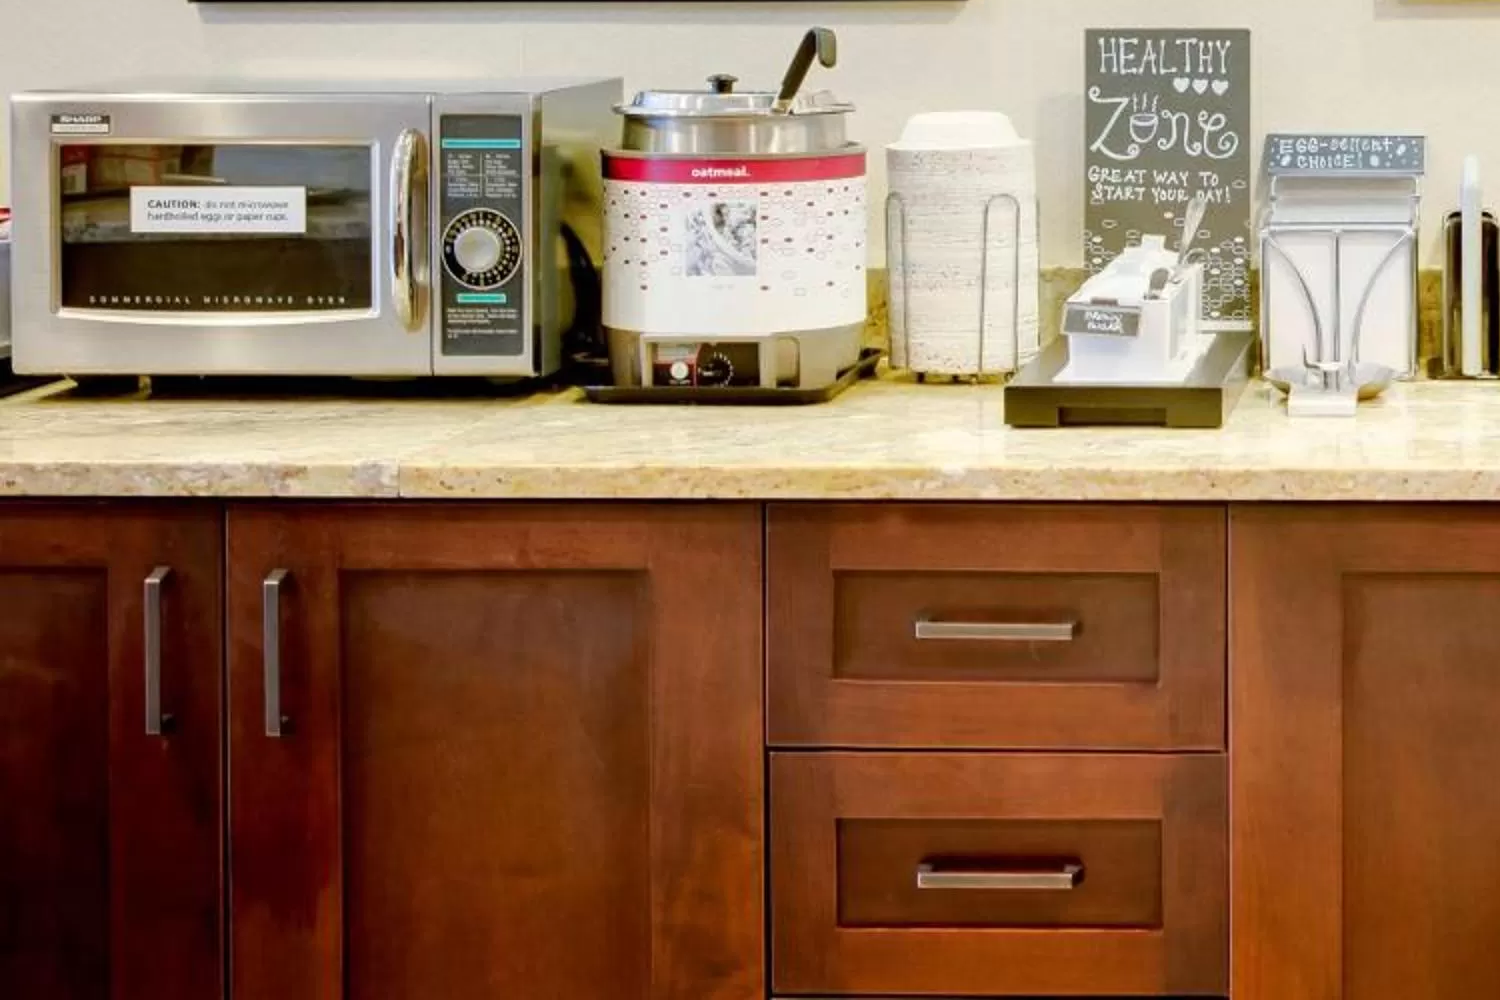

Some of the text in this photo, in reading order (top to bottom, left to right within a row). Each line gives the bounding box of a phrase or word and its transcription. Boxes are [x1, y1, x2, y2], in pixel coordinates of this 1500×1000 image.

[1098, 36, 1231, 75] HEALTHY
[1088, 165, 1219, 186] GREAT WAY TO
[1091, 183, 1231, 204] START YOUR DAY!
[147, 200, 201, 209] CAUTION:
